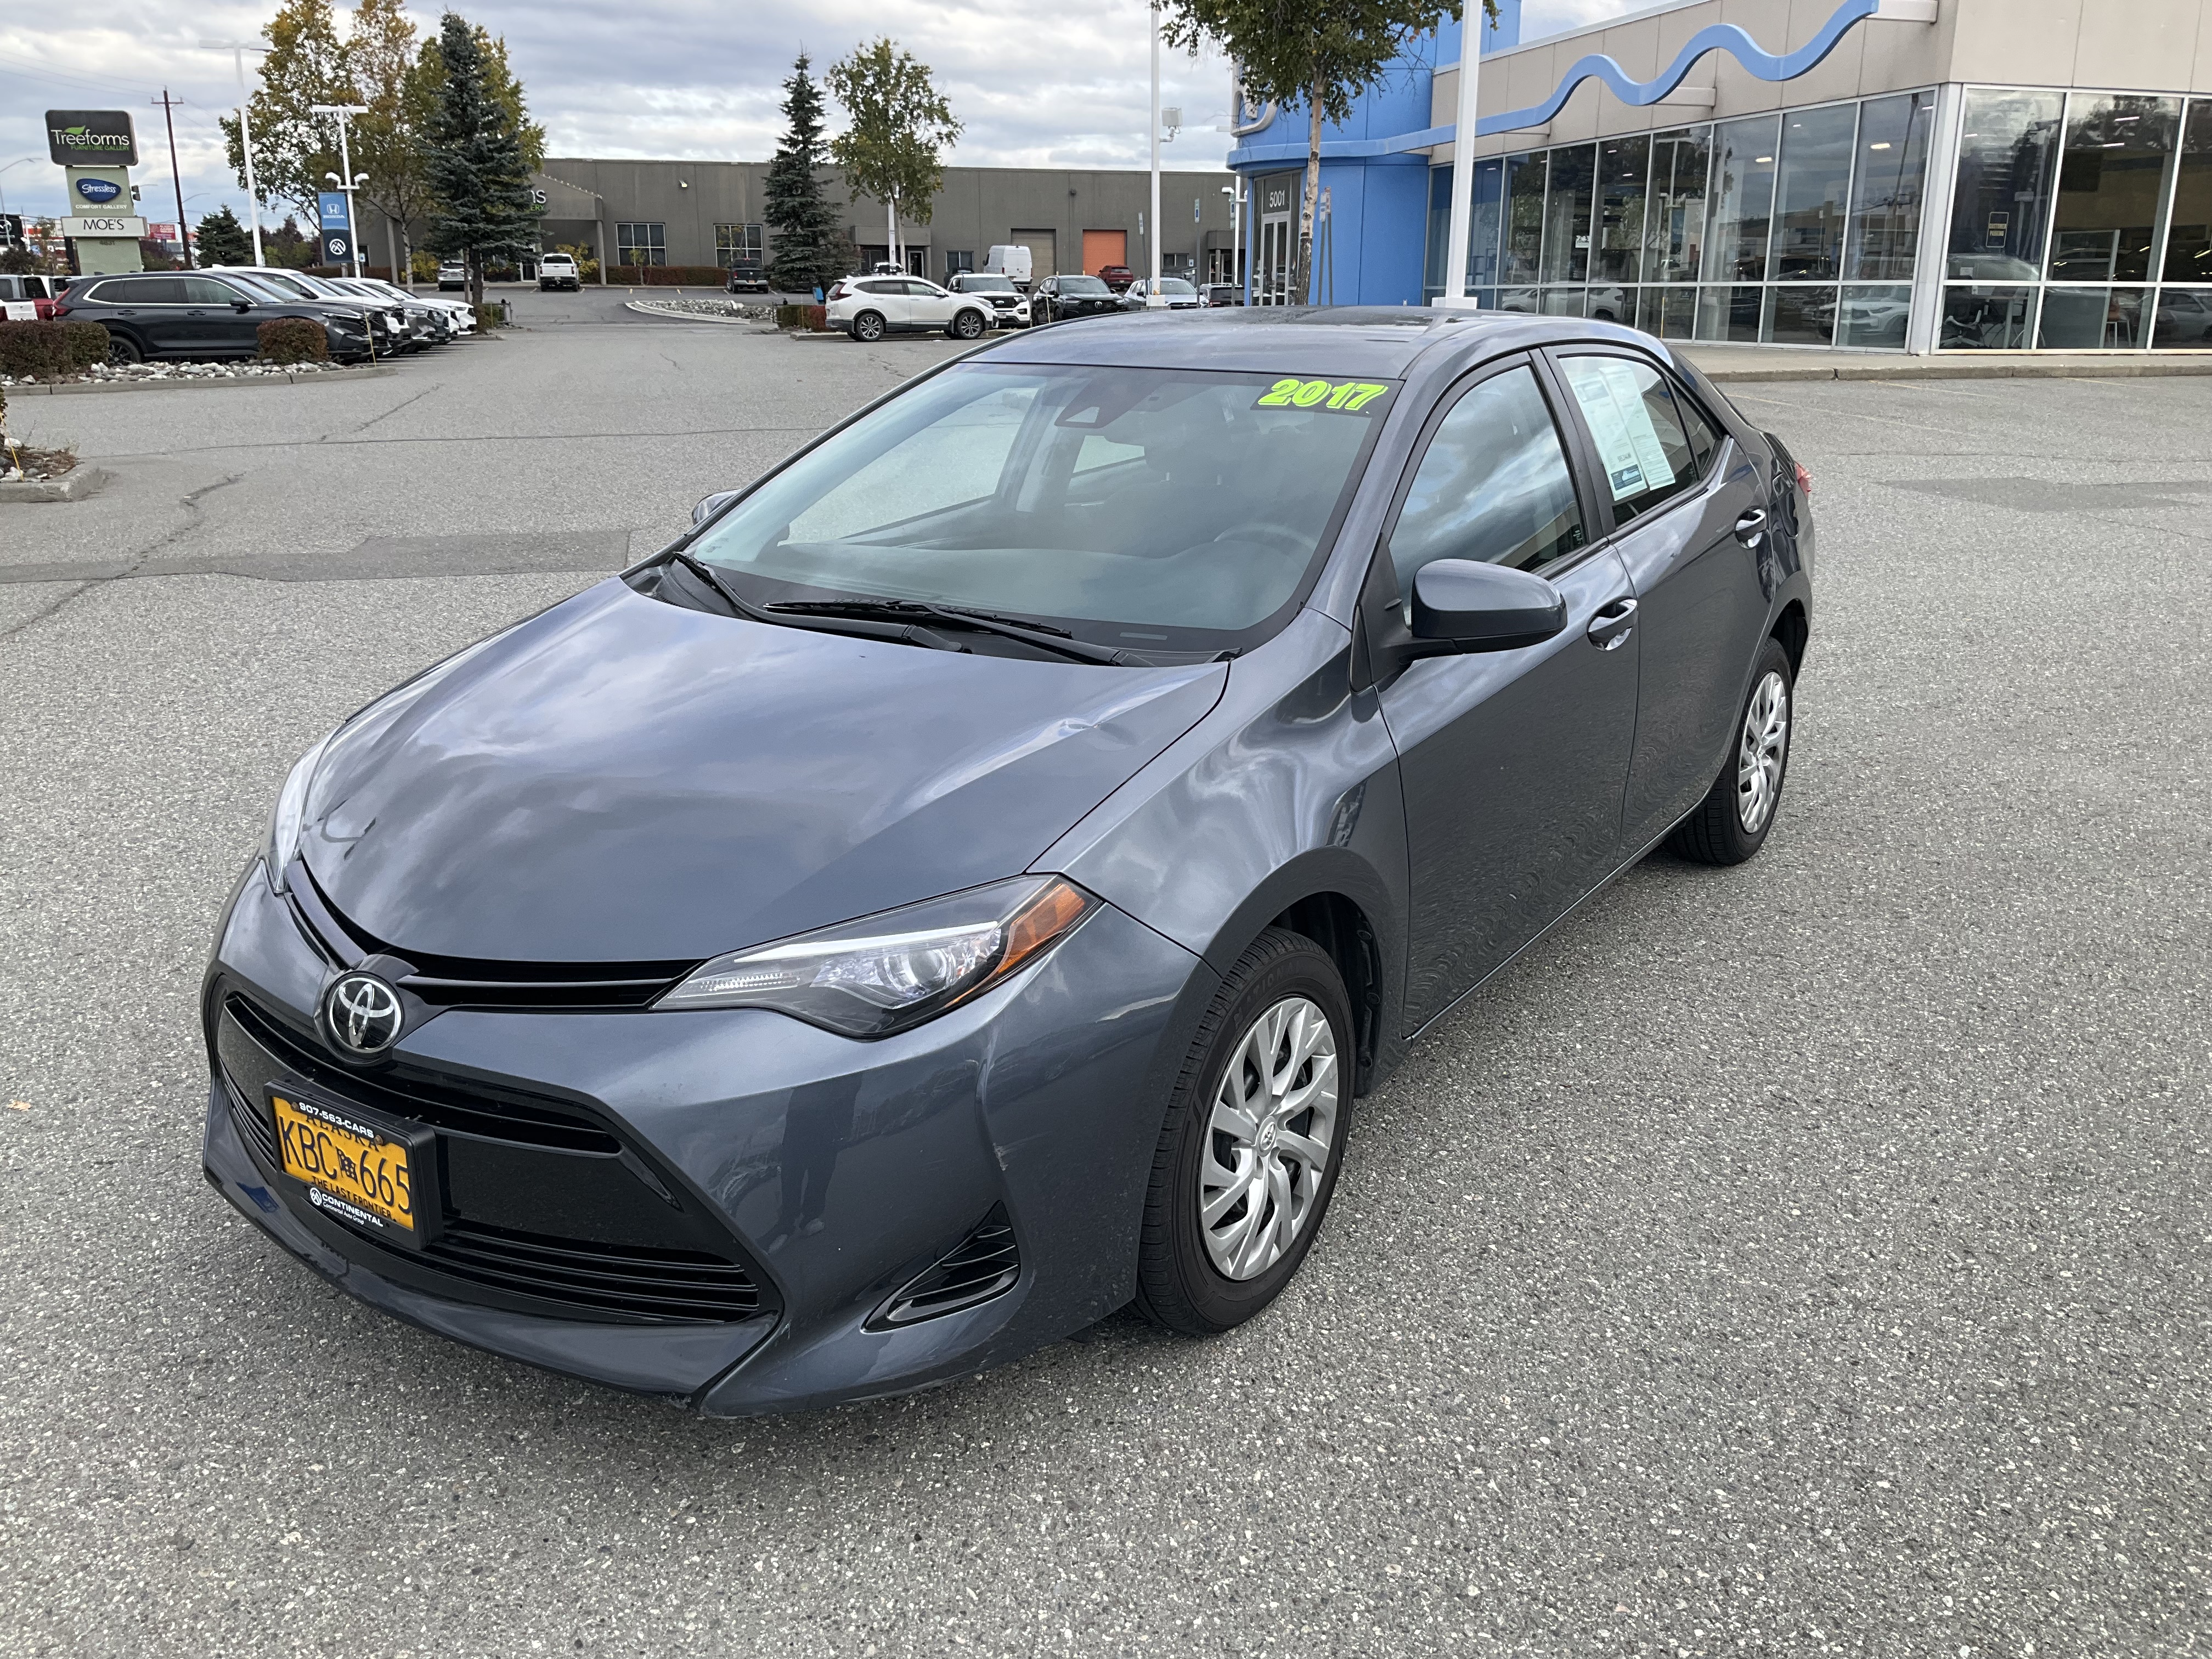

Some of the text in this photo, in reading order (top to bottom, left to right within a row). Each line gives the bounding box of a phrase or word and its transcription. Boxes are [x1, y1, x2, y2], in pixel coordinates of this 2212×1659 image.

[50, 129, 130, 145] Treeforms
[82, 184, 116, 194] Stressless
[1269, 190, 1285, 208] 5001
[83, 219, 125, 230] MOE'S
[299, 1102, 374, 1138] 907-563-CARS
[279, 1115, 411, 1214] KBC 665
[312, 1176, 392, 1218] THE LAST FRONTIER
[321, 1194, 383, 1227] CONTINENTAL
[353, 1215, 364, 1225] Group
[1257, 1476, 1389, 1508] 2017
